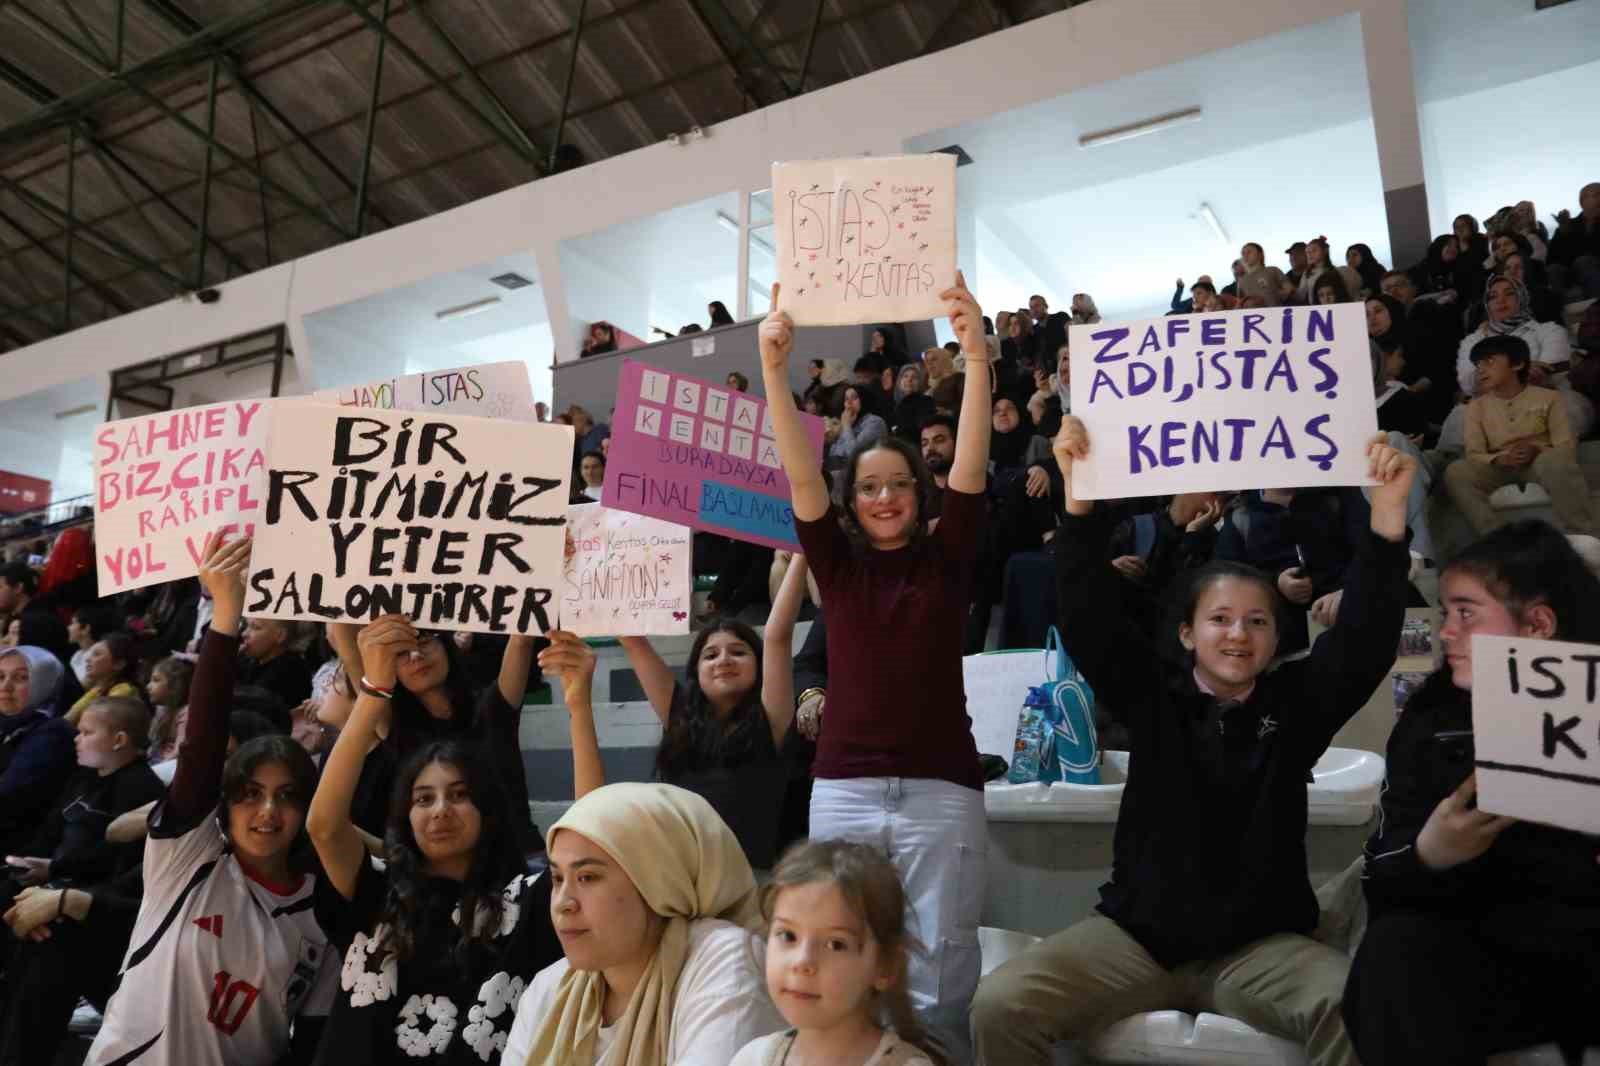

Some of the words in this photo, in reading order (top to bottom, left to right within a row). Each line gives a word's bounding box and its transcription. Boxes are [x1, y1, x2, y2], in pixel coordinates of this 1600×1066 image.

[1090, 308, 1335, 363] ZAFERİN
[332, 417, 467, 470] BİR
[1128, 413, 1339, 475] KENTAŞ
[265, 466, 567, 526] RİTMİMİZ
[617, 473, 697, 513] FİNAL
[104, 543, 167, 587] YOL
[328, 522, 534, 578] YETER
[1542, 712, 1600, 759] K
[207, 970, 258, 1037] 10
